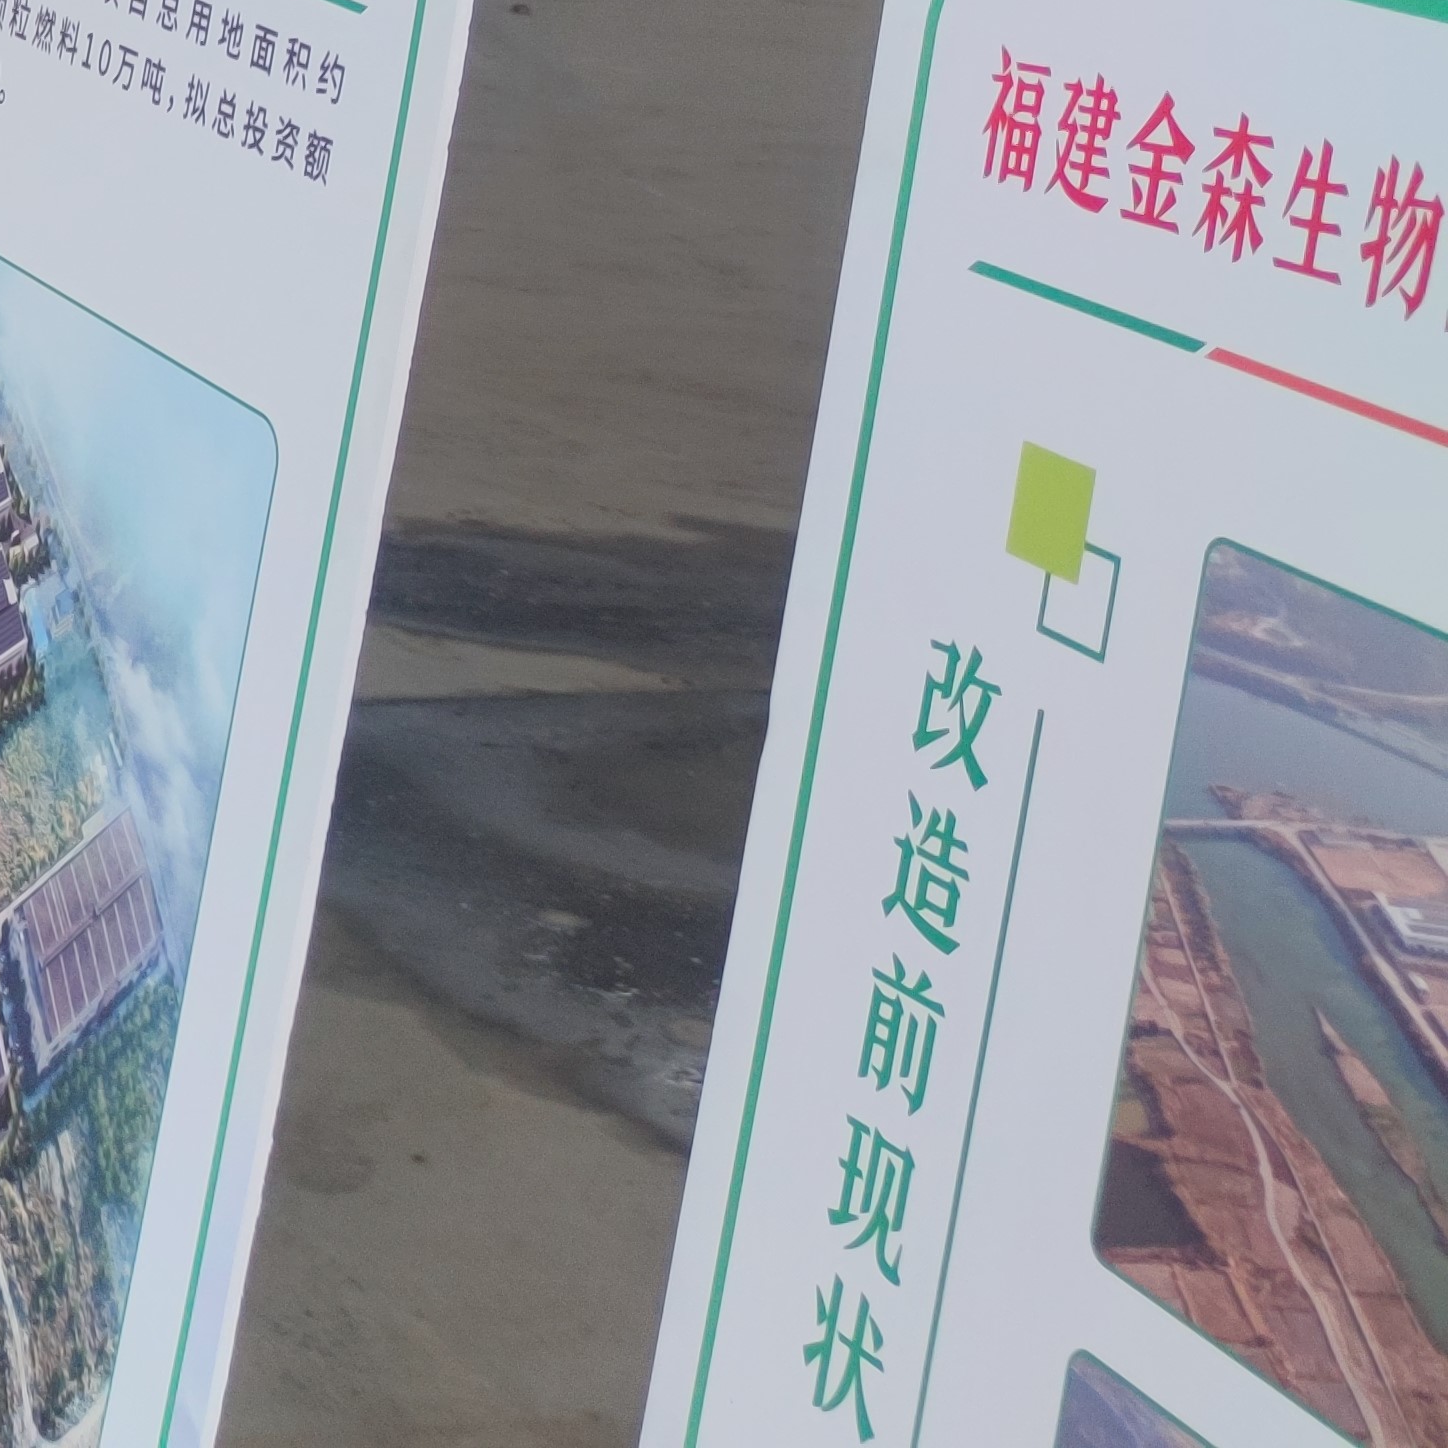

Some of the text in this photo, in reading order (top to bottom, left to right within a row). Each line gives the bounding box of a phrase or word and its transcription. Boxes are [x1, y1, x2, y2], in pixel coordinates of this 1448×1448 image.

[981, 45, 1446, 320] 福建金森生物
[801, 637, 1003, 1445] 改造前现状
